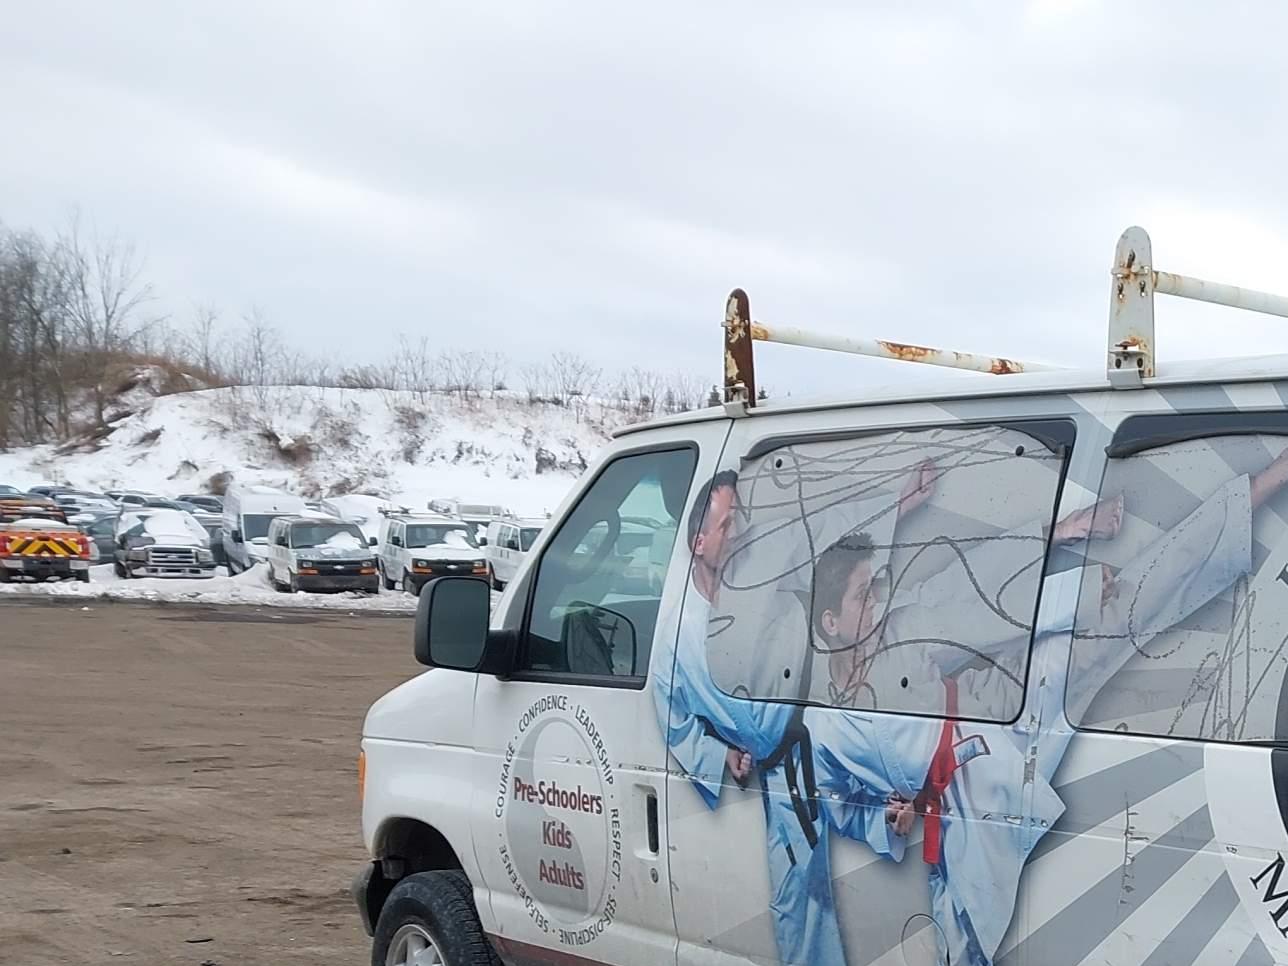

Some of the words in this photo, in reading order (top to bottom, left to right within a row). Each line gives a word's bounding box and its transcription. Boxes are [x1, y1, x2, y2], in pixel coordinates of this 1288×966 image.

[518, 695, 568, 733] CONFIDENCE
[575, 704, 614, 785] LEADERSHIP
[495, 742, 515, 818] COURAGE
[513, 776, 603, 815] Pre-Schoolers
[542, 820, 572, 850] Kids
[610, 808, 622, 881] RESPECT
[499, 844, 549, 934] SELF-DEFENSE
[539, 858, 585, 891] Adults
[559, 893, 618, 947] SELF-DISCIPLINE
